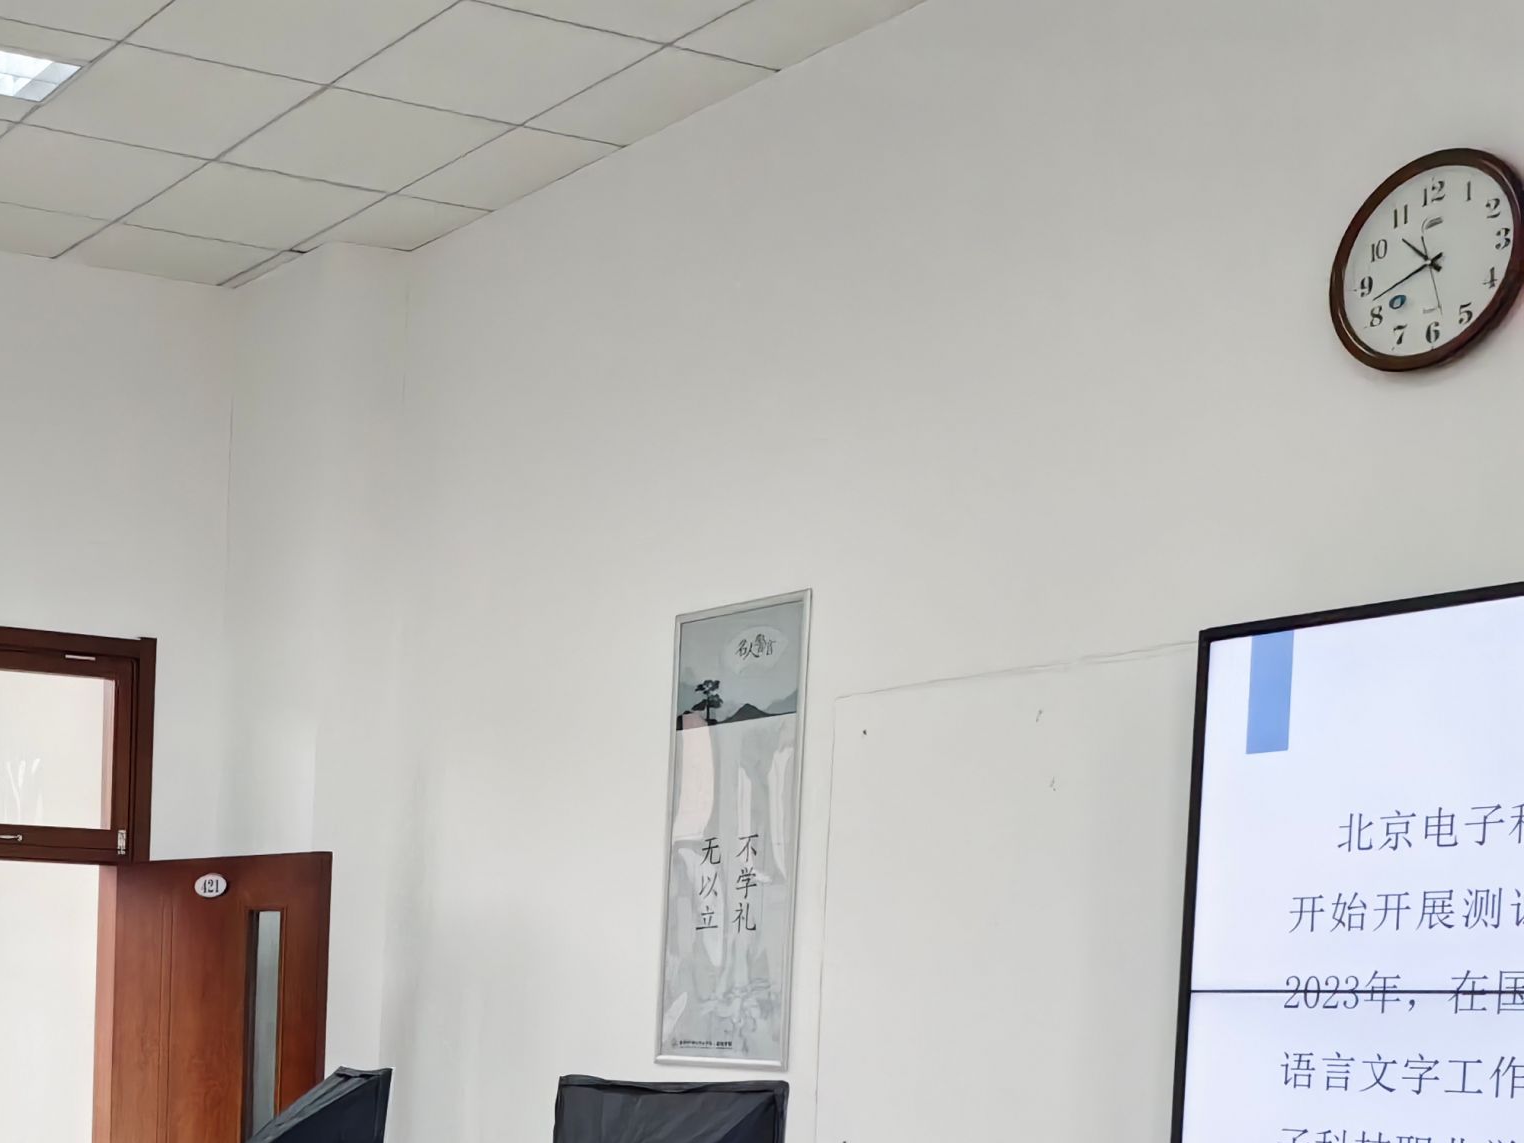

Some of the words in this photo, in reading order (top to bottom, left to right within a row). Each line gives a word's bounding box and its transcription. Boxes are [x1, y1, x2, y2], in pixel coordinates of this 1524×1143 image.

[1422, 180, 1446, 208] 12
[1464, 180, 1472, 202] 1
[1392, 204, 1409, 229] 11
[1485, 198, 1501, 219] 2
[1494, 227, 1511, 250] 3
[1370, 238, 1388, 263] 10
[1359, 275, 1374, 298] 9
[1482, 266, 1499, 289] 4
[1368, 305, 1384, 328] 8
[1457, 302, 1474, 325] 5
[1392, 323, 1408, 345] 7
[1425, 321, 1441, 344] 6
[695, 836, 722, 931] 无以立
[732, 833, 759, 934] 不学礼
[1280, 1051, 1524, 1099] 语言文字工作
